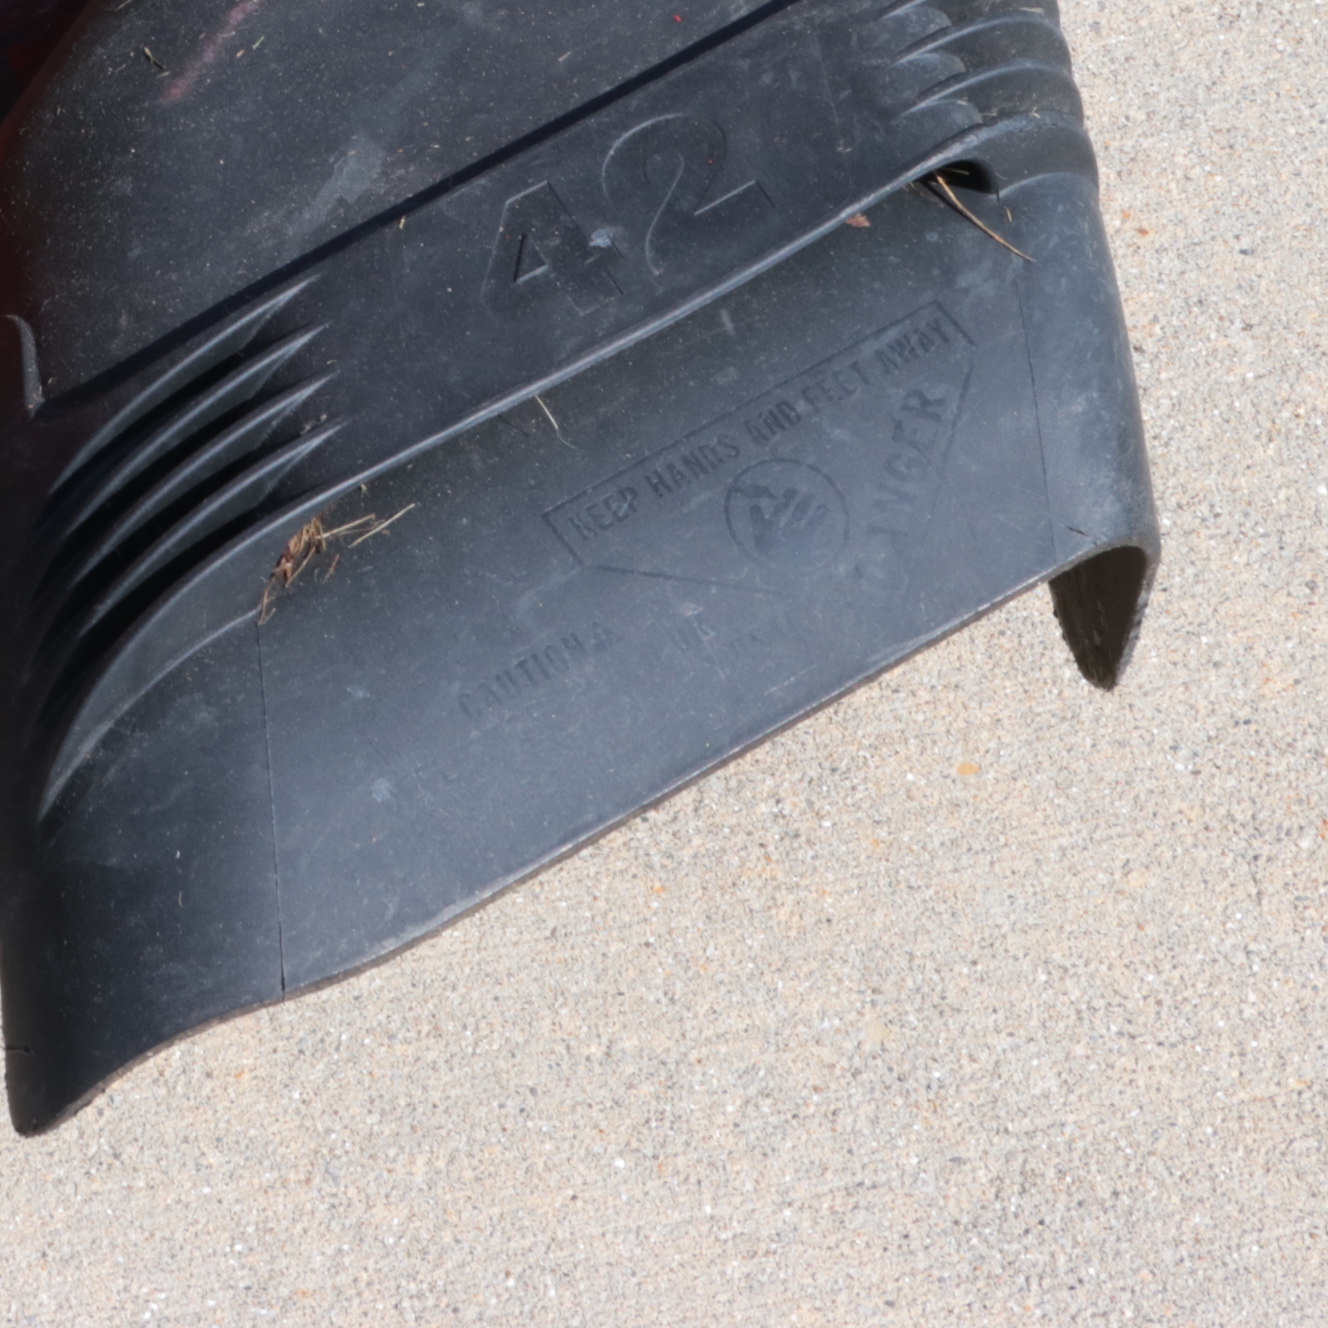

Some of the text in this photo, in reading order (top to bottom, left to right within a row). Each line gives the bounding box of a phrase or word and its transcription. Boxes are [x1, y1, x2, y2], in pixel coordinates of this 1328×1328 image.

[478, 111, 780, 324] 42
[567, 317, 951, 542] KEEP HANDS AND FEET AWAY
[457, 631, 588, 720] CAUTION
